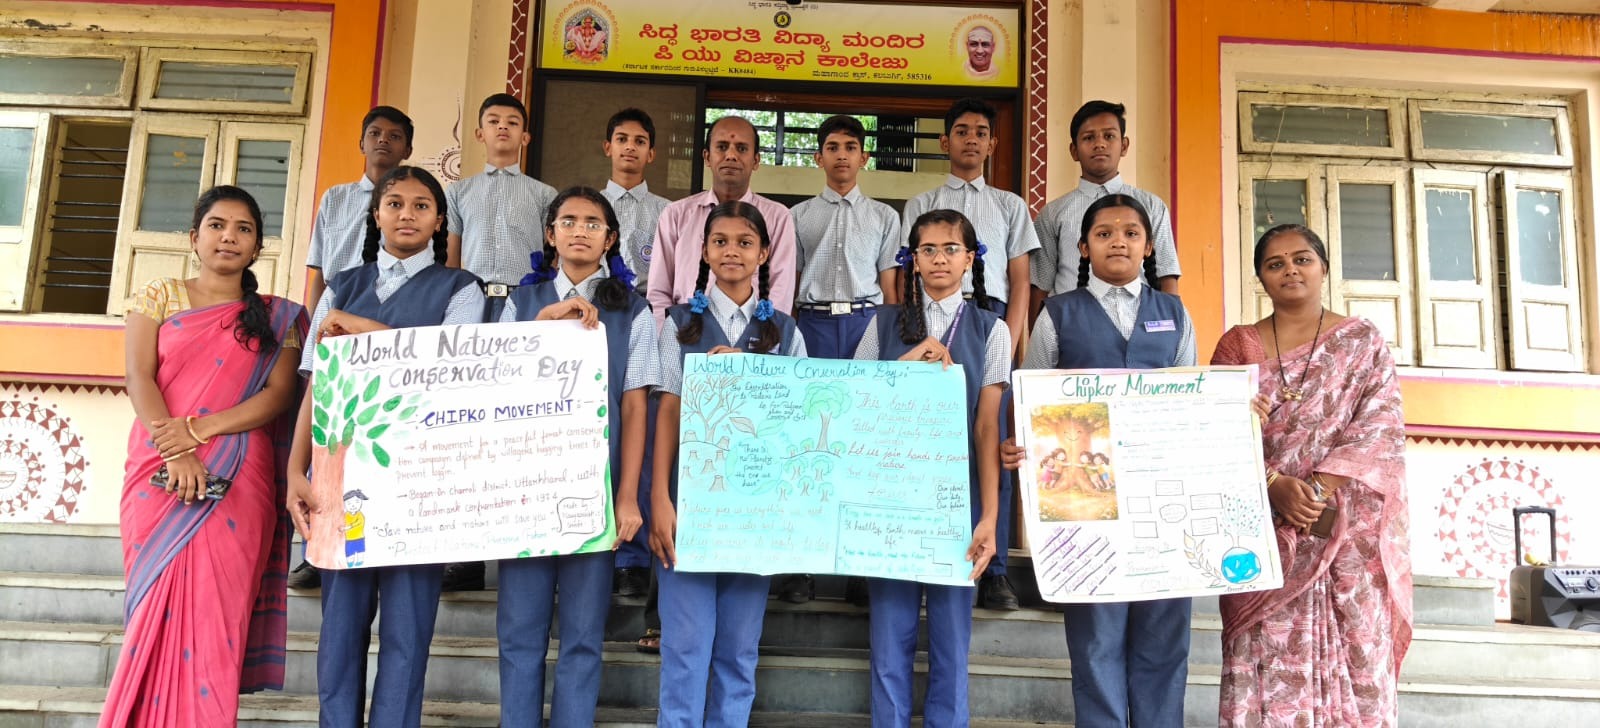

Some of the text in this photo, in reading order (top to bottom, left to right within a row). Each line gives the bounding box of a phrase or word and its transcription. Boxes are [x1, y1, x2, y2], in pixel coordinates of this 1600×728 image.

[639, 23, 925, 52] ಸಿದ್ಧ ಭಾರತಿ ವಿದ್ಯಾ ಮಂದಿರ
[654, 44, 909, 71] ಪಿ ಯು ವಿಜ್ಞಾನ ಕಾಲೇಜು
[347, 325, 541, 365] World Nature's
[389, 355, 583, 399] Conservation Day
[693, 355, 736, 374] World
[741, 355, 786, 377] Nature
[1061, 372, 1206, 403] Chipko Movement
[420, 399, 574, 427] CHIPKO MOVEMENT
